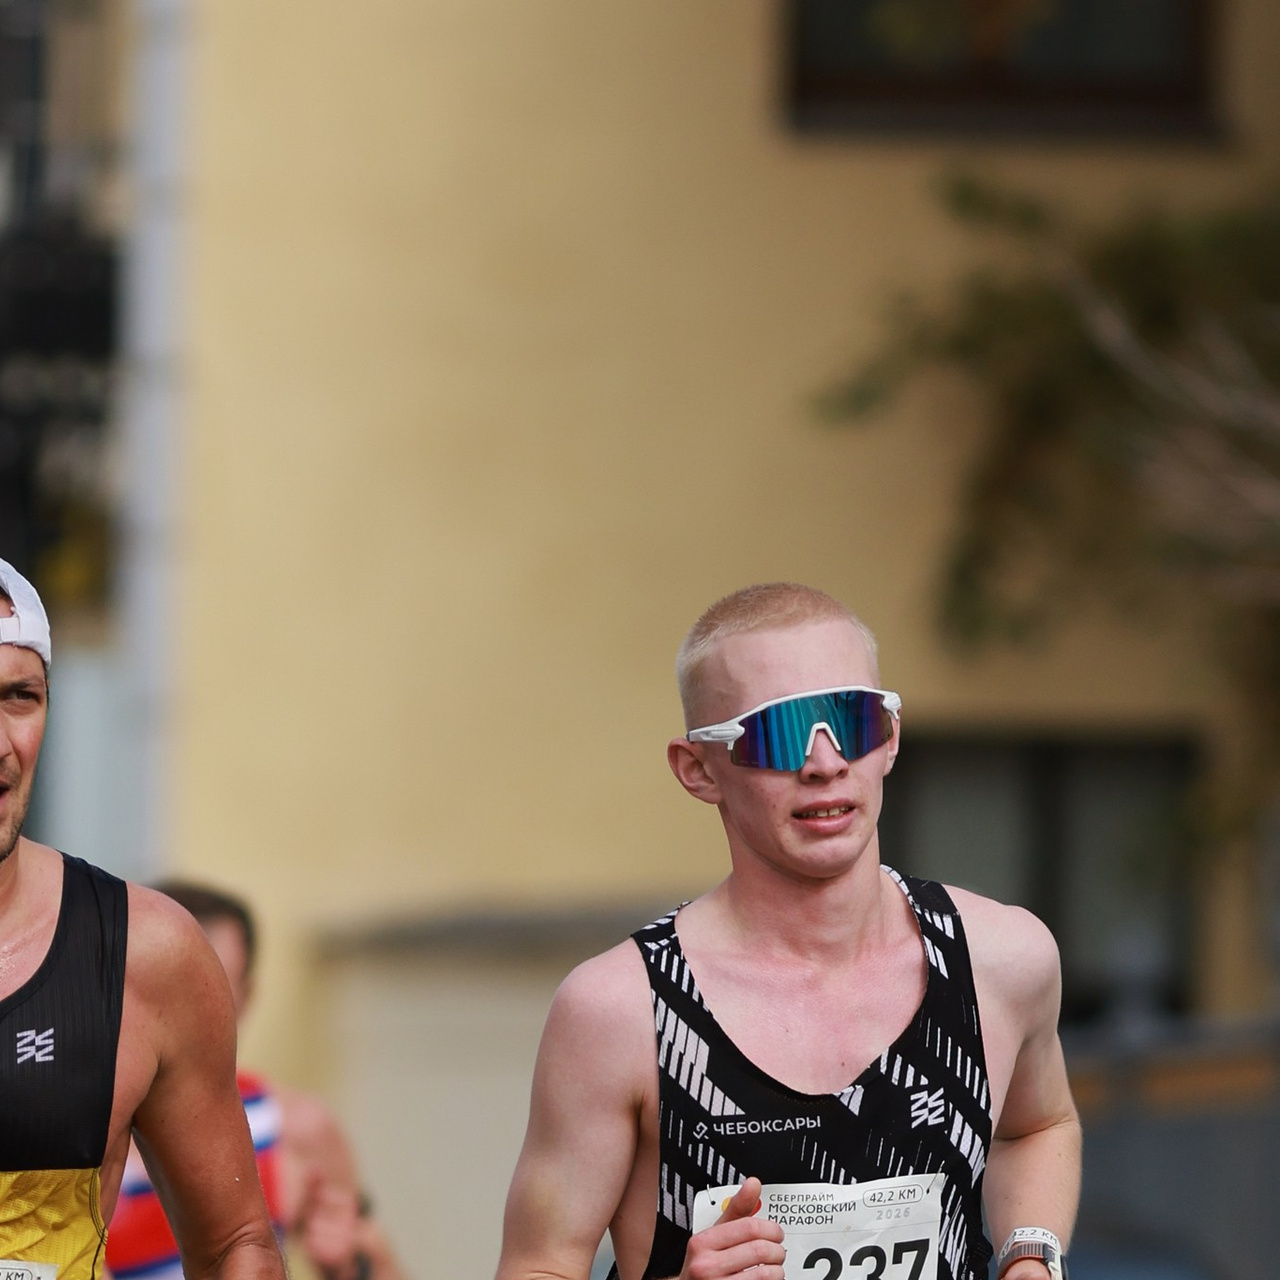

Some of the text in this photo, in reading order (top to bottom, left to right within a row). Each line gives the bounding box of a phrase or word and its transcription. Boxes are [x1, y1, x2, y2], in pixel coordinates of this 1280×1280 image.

[713, 1115, 821, 1136] ЧЕБОКСАРЫ
[769, 1192, 834, 1202] СБЕРПРАЙМ
[870, 1191, 894, 1204] 42,2
[768, 1201, 857, 1213] МОСКОВСКИЙ
[768, 1214, 834, 1226] МАРАФОН
[875, 1207, 911, 1221] 2026
